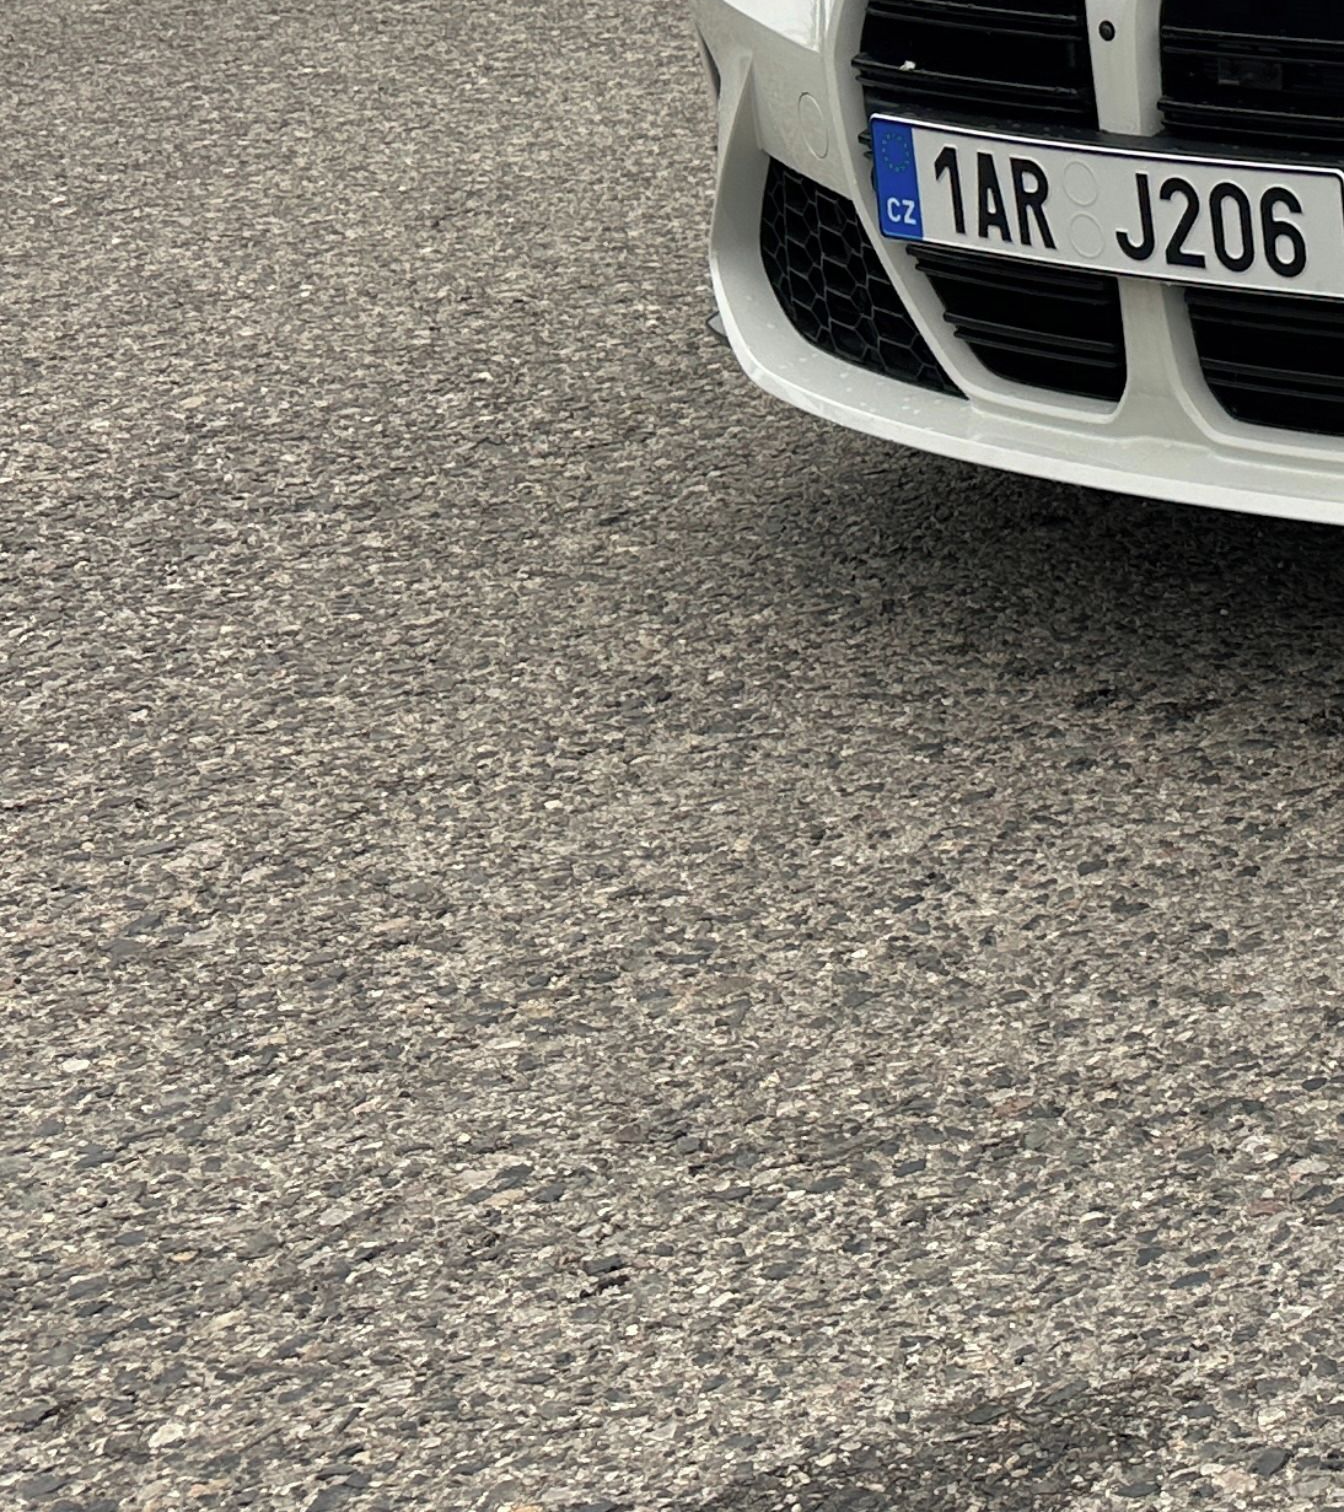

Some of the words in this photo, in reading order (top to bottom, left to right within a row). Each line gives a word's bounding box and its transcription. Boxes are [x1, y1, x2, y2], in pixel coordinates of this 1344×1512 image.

[887, 196, 918, 225] CZ
[934, 146, 1057, 251] 1AR
[1116, 173, 1308, 279] J206
